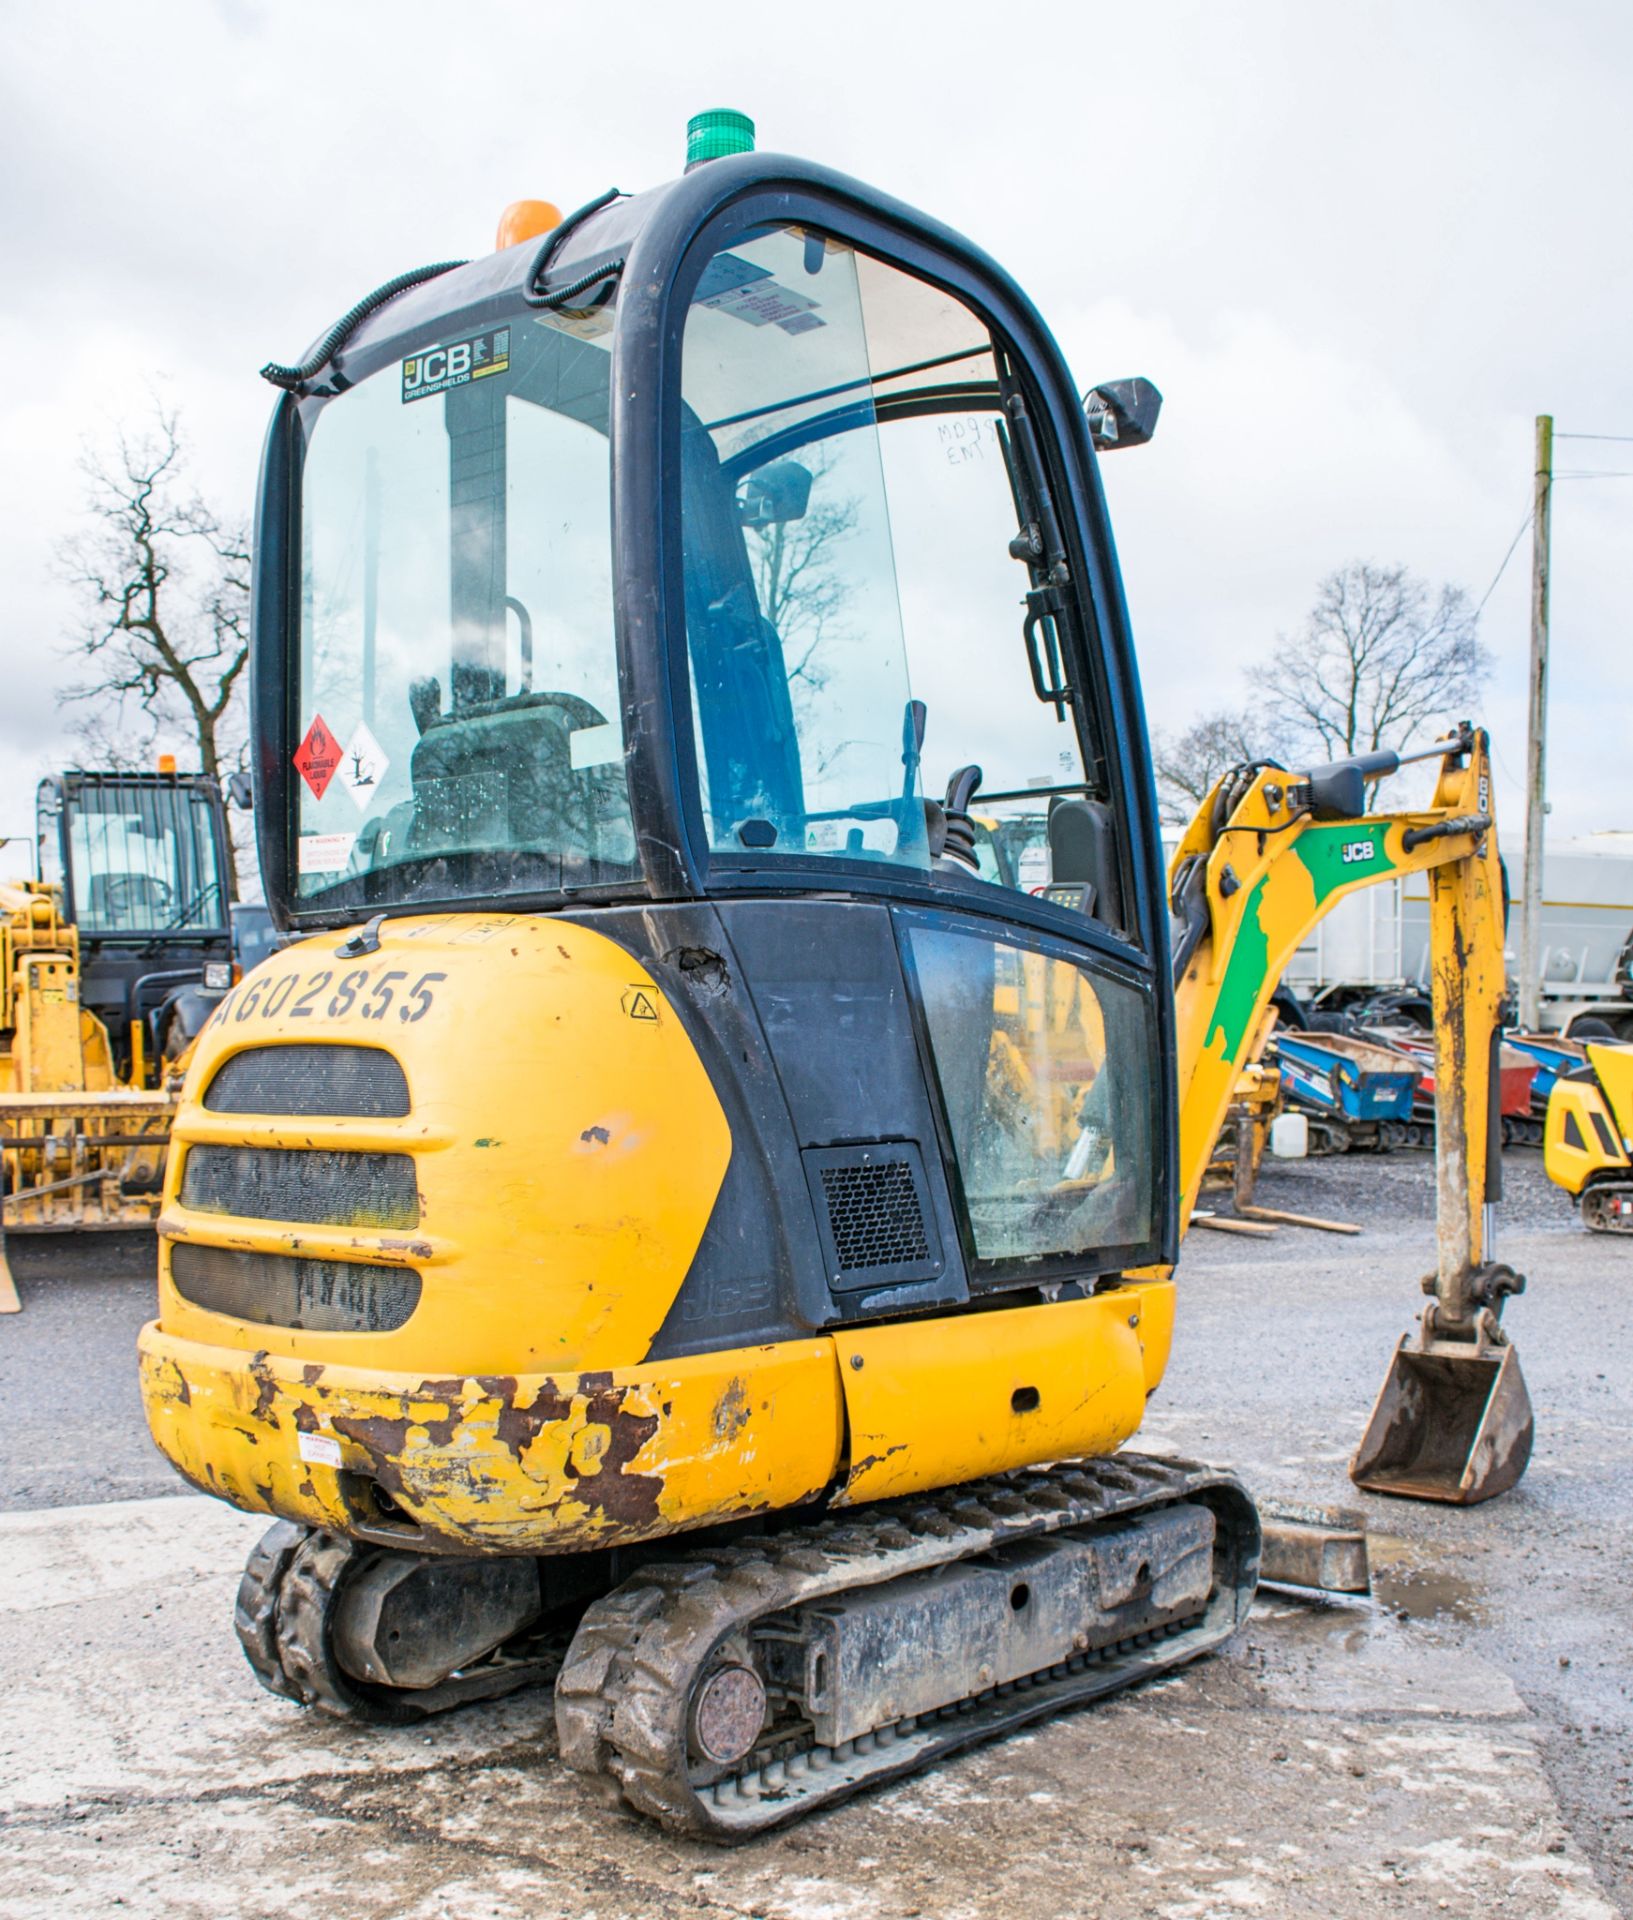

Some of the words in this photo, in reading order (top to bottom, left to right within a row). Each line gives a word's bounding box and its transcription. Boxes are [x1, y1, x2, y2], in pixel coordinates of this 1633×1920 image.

[404, 343, 471, 390] JCB
[404, 372, 471, 400] GREENSHIELDS
[1342, 841, 1374, 863] JCB
[683, 1276, 771, 1321] JCB
